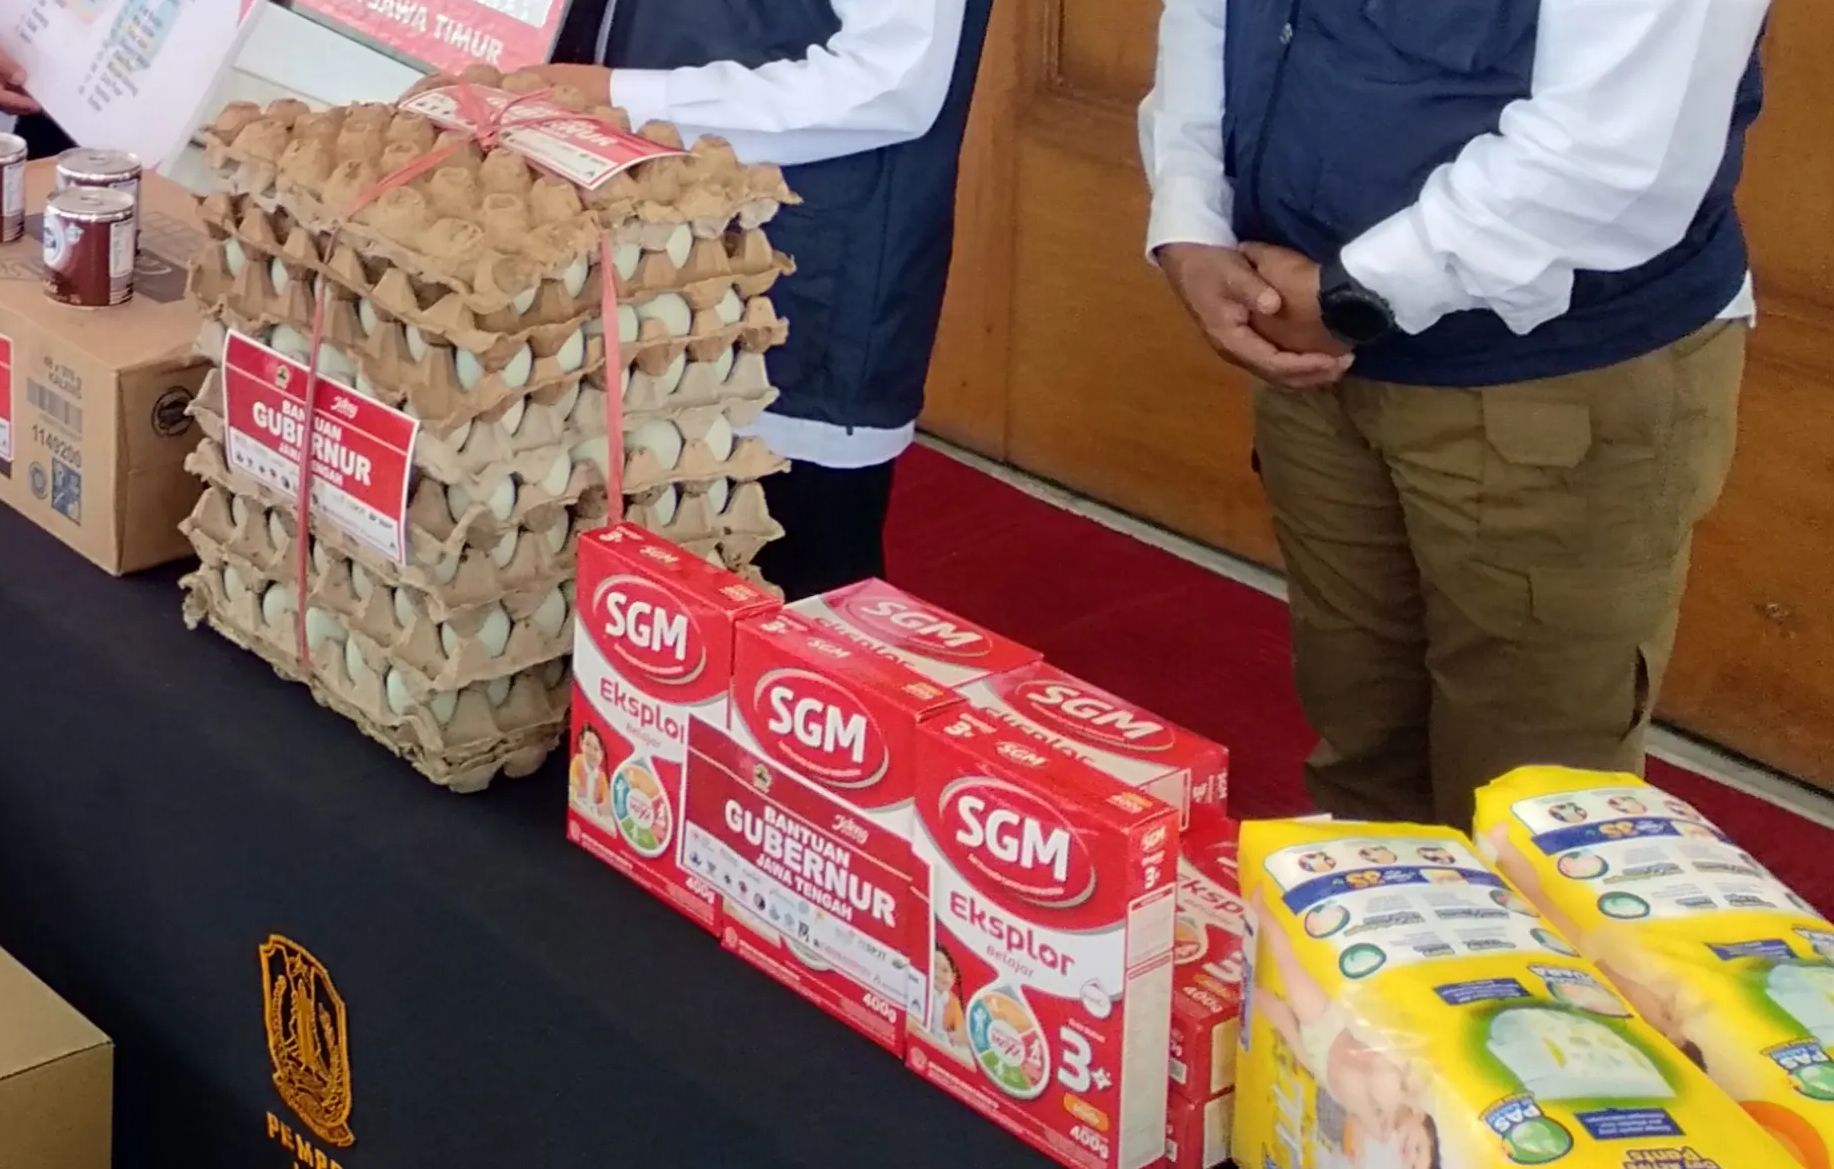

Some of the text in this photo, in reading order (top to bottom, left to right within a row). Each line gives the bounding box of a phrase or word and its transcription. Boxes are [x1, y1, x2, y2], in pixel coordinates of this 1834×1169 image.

[433, 13, 505, 65] TIMUR
[282, 399, 342, 442] BANUAN
[605, 591, 688, 662] SGM
[860, 600, 983, 648] SGM
[768, 685, 867, 764] SGM
[1026, 683, 1164, 741] SGM
[724, 799, 896, 928] GUBERNUR
[764, 805, 850, 867] BANTUAN
[956, 795, 1071, 882] SGM
[755, 853, 854, 921] JAWA TENGAH
[950, 889, 1076, 976] Eksplor
[863, 992, 897, 1024] 400g
